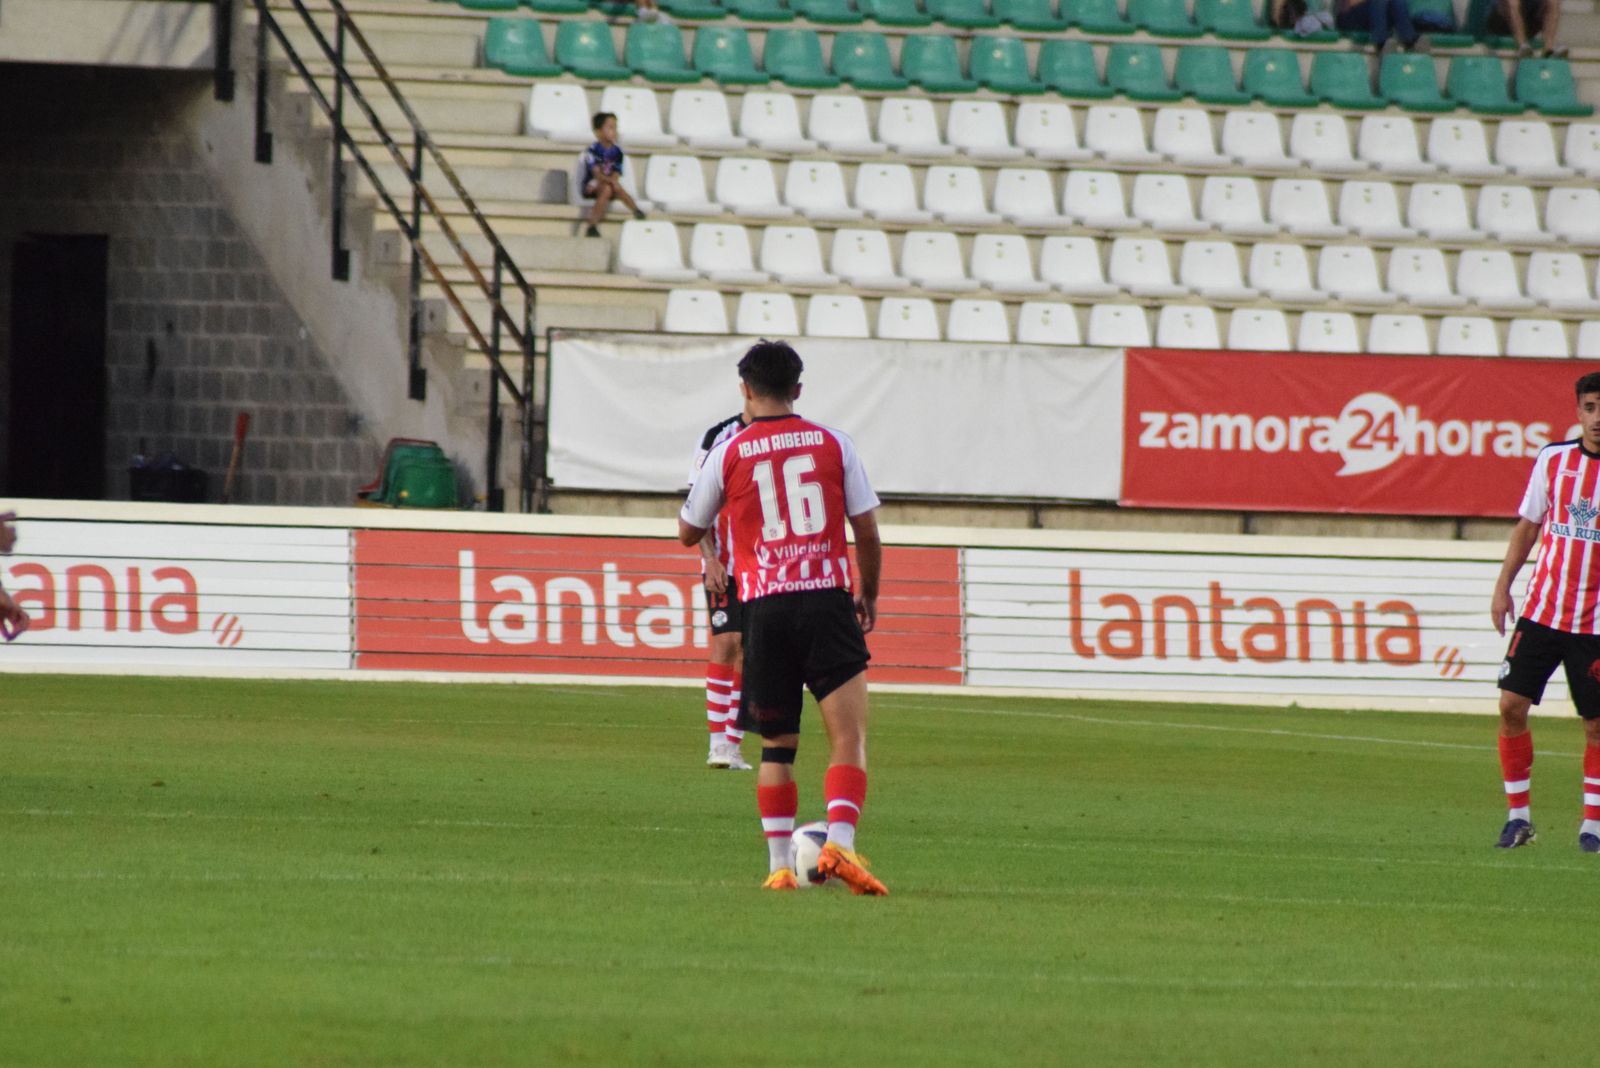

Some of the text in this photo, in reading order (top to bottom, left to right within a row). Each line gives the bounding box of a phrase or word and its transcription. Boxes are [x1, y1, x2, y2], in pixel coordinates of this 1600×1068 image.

[738, 430, 824, 459] IBAN RIBEIRO
[752, 454, 827, 543] 16
[1575, 526, 1600, 542] RUR
[8, 562, 199, 635] ania
[458, 549, 709, 650] lanta
[767, 573, 837, 594] Pronatal
[1068, 568, 1421, 667] lantania
